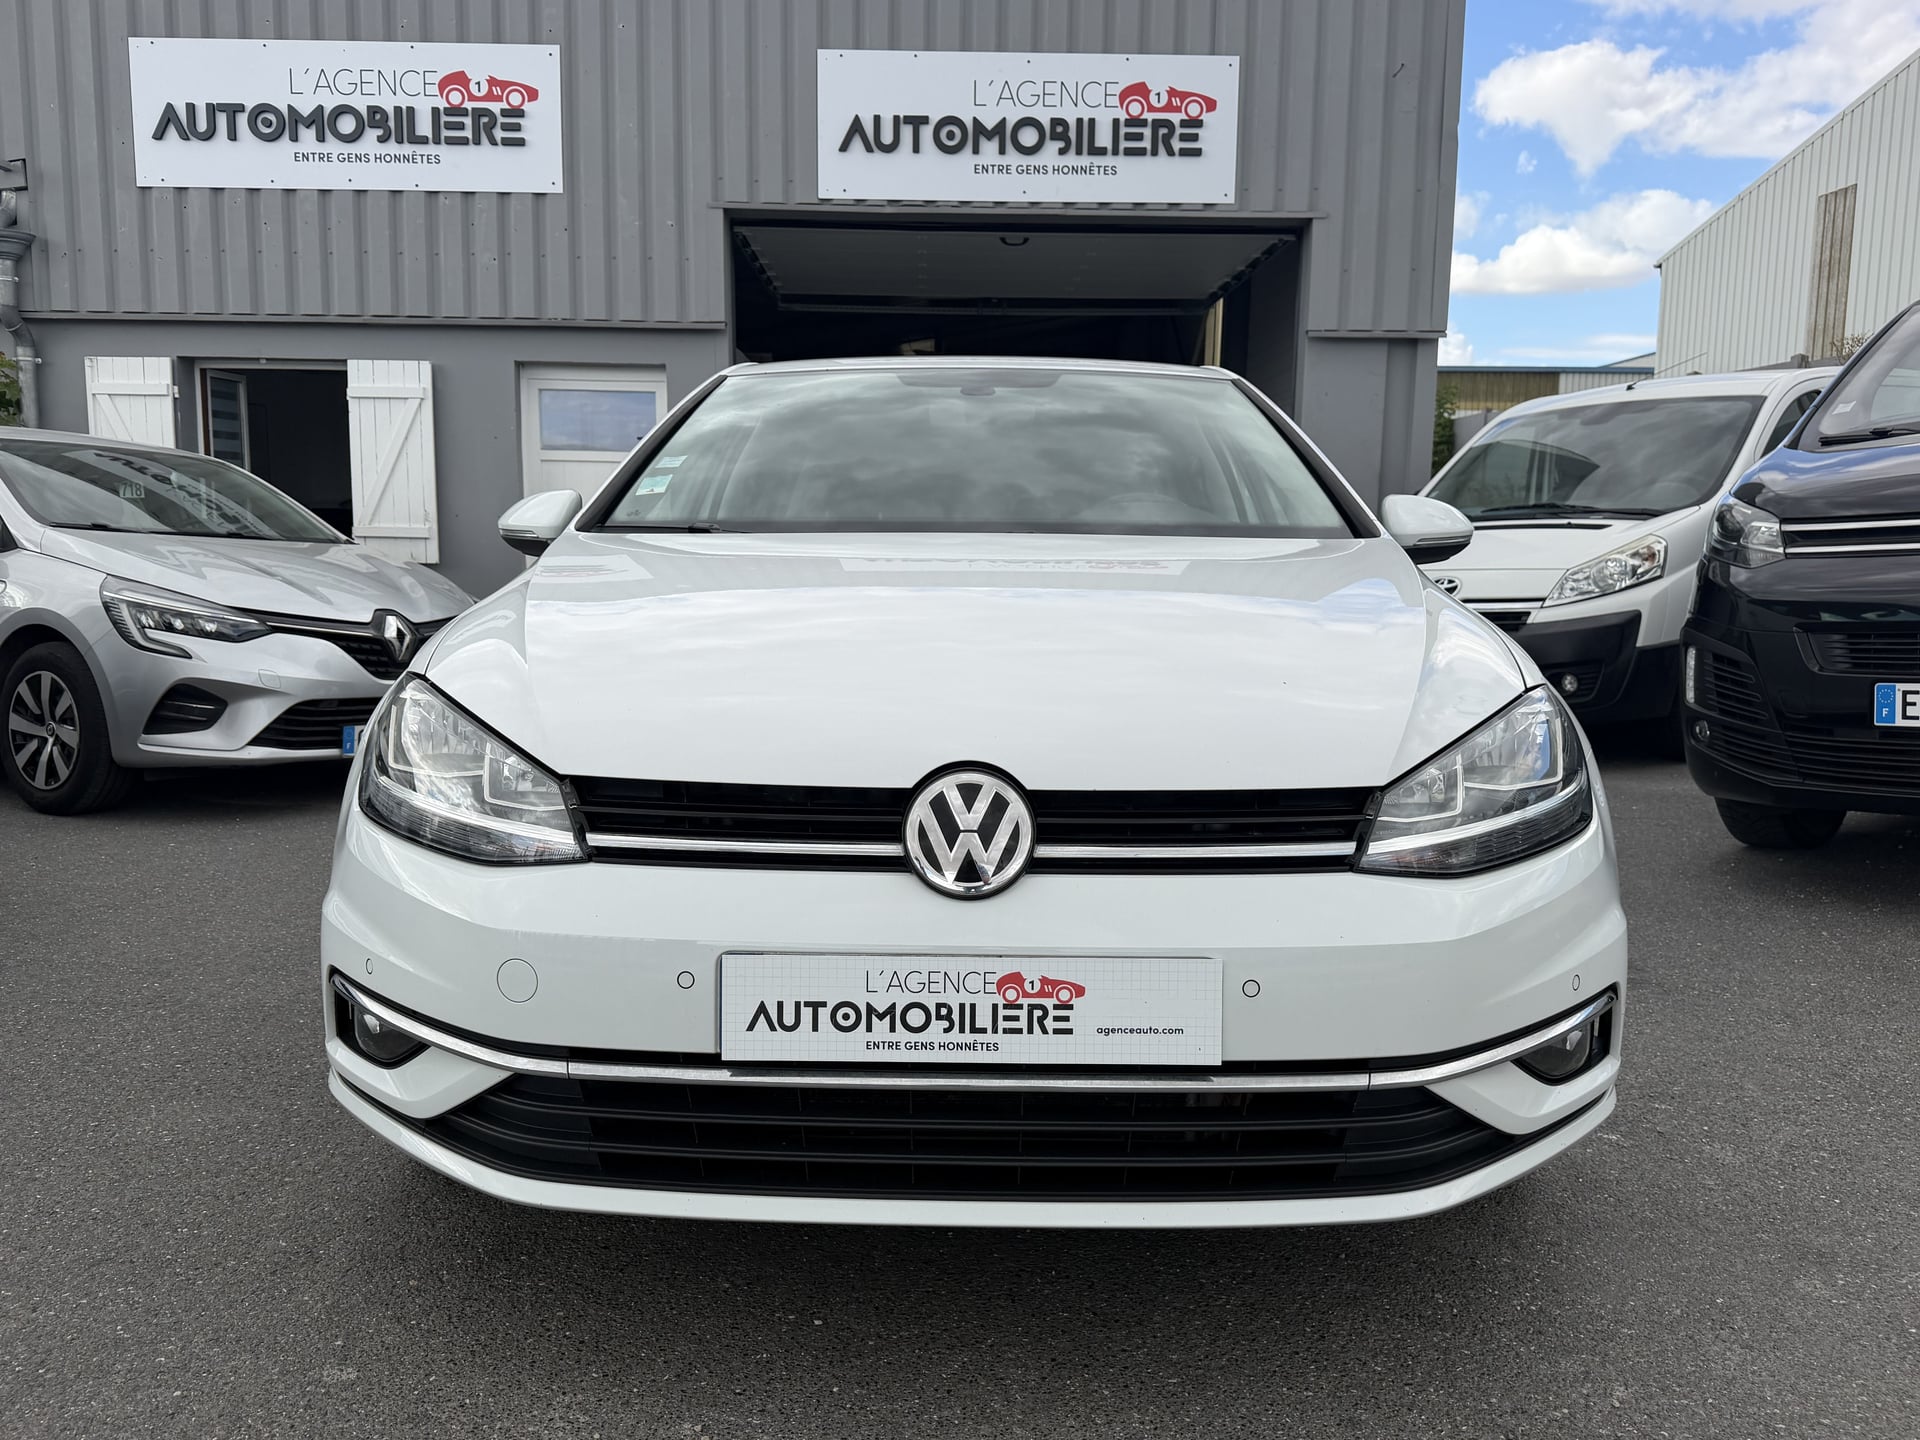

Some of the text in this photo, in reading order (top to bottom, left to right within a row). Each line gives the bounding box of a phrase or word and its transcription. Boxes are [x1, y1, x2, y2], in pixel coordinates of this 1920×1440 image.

[474, 80, 481, 93] 1
[1154, 91, 1161, 104] 1
[293, 150, 441, 165] ENTRE GENS HONNÊTES
[973, 161, 1118, 176] ENTRE GENS HONNÊTES
[121, 482, 143, 497] 718
[1028, 979, 1035, 991] 1
[1096, 1025, 1184, 1037] agenceauto.com
[865, 1038, 1000, 1052] ENTRE GENS HONNÊTES
